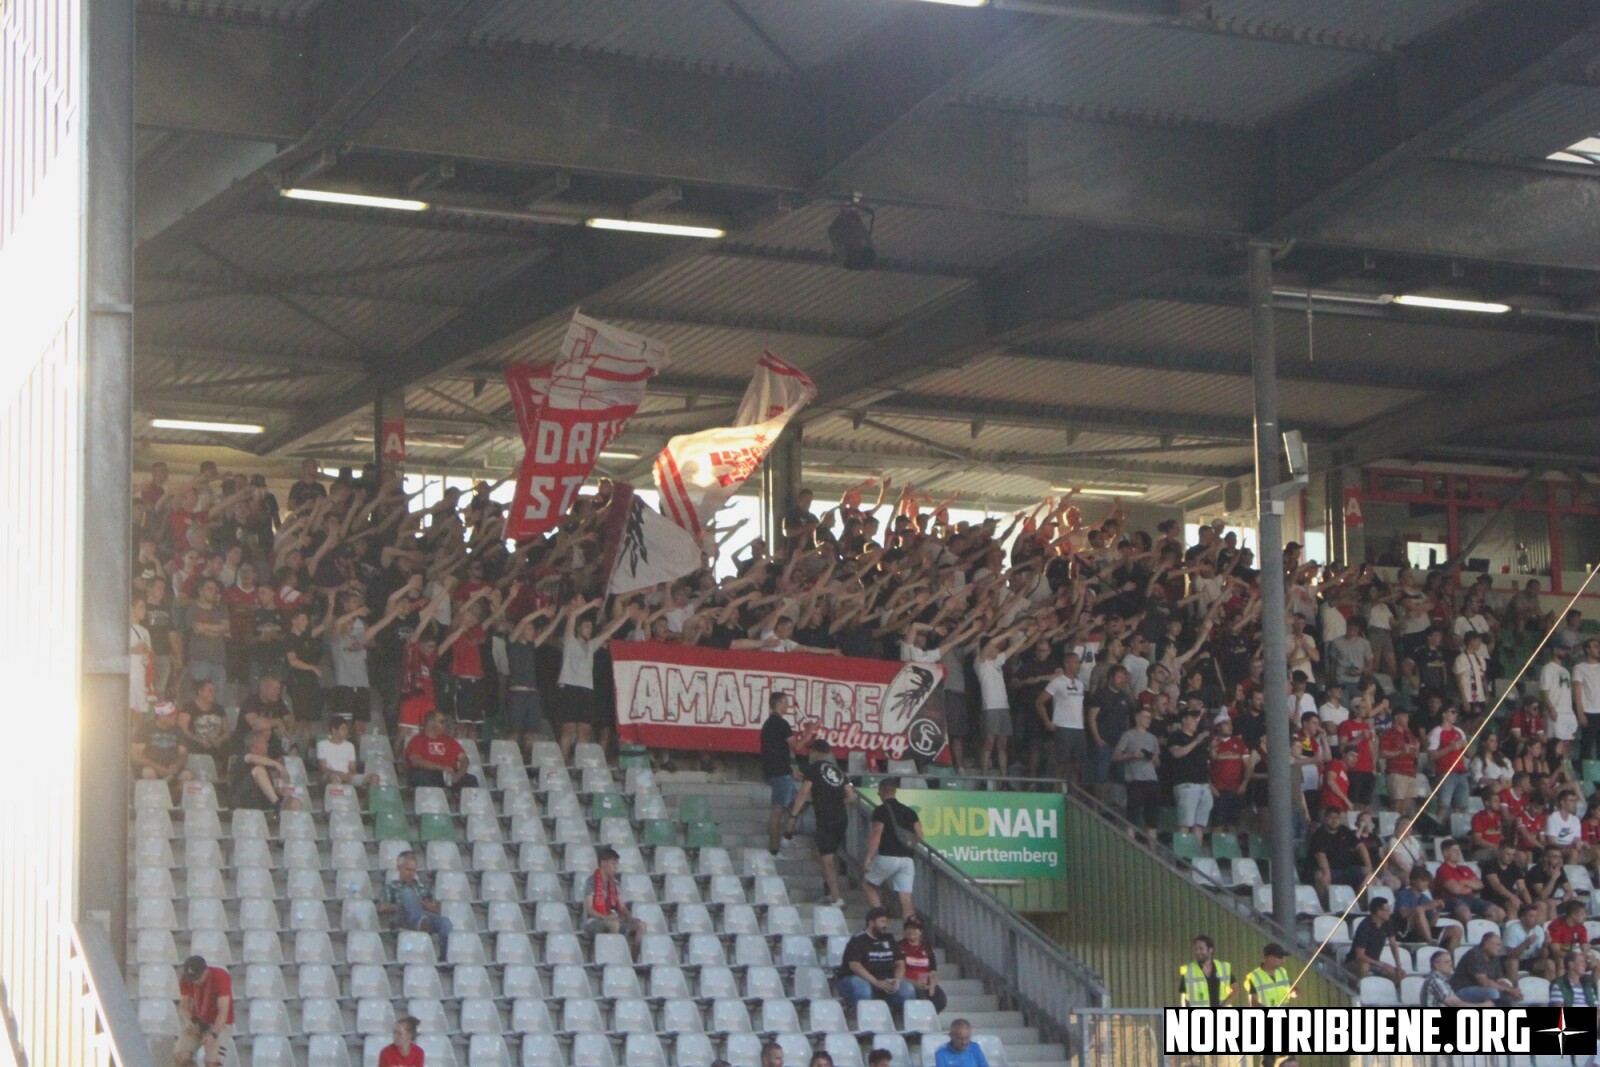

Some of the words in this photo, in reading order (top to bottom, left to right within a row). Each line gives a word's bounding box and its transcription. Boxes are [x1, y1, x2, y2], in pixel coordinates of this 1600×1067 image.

[384, 432, 403, 453] A
[1346, 497, 1362, 516] A
[630, 665, 881, 734] AMATEURE
[909, 804, 1058, 838] UNDNAH
